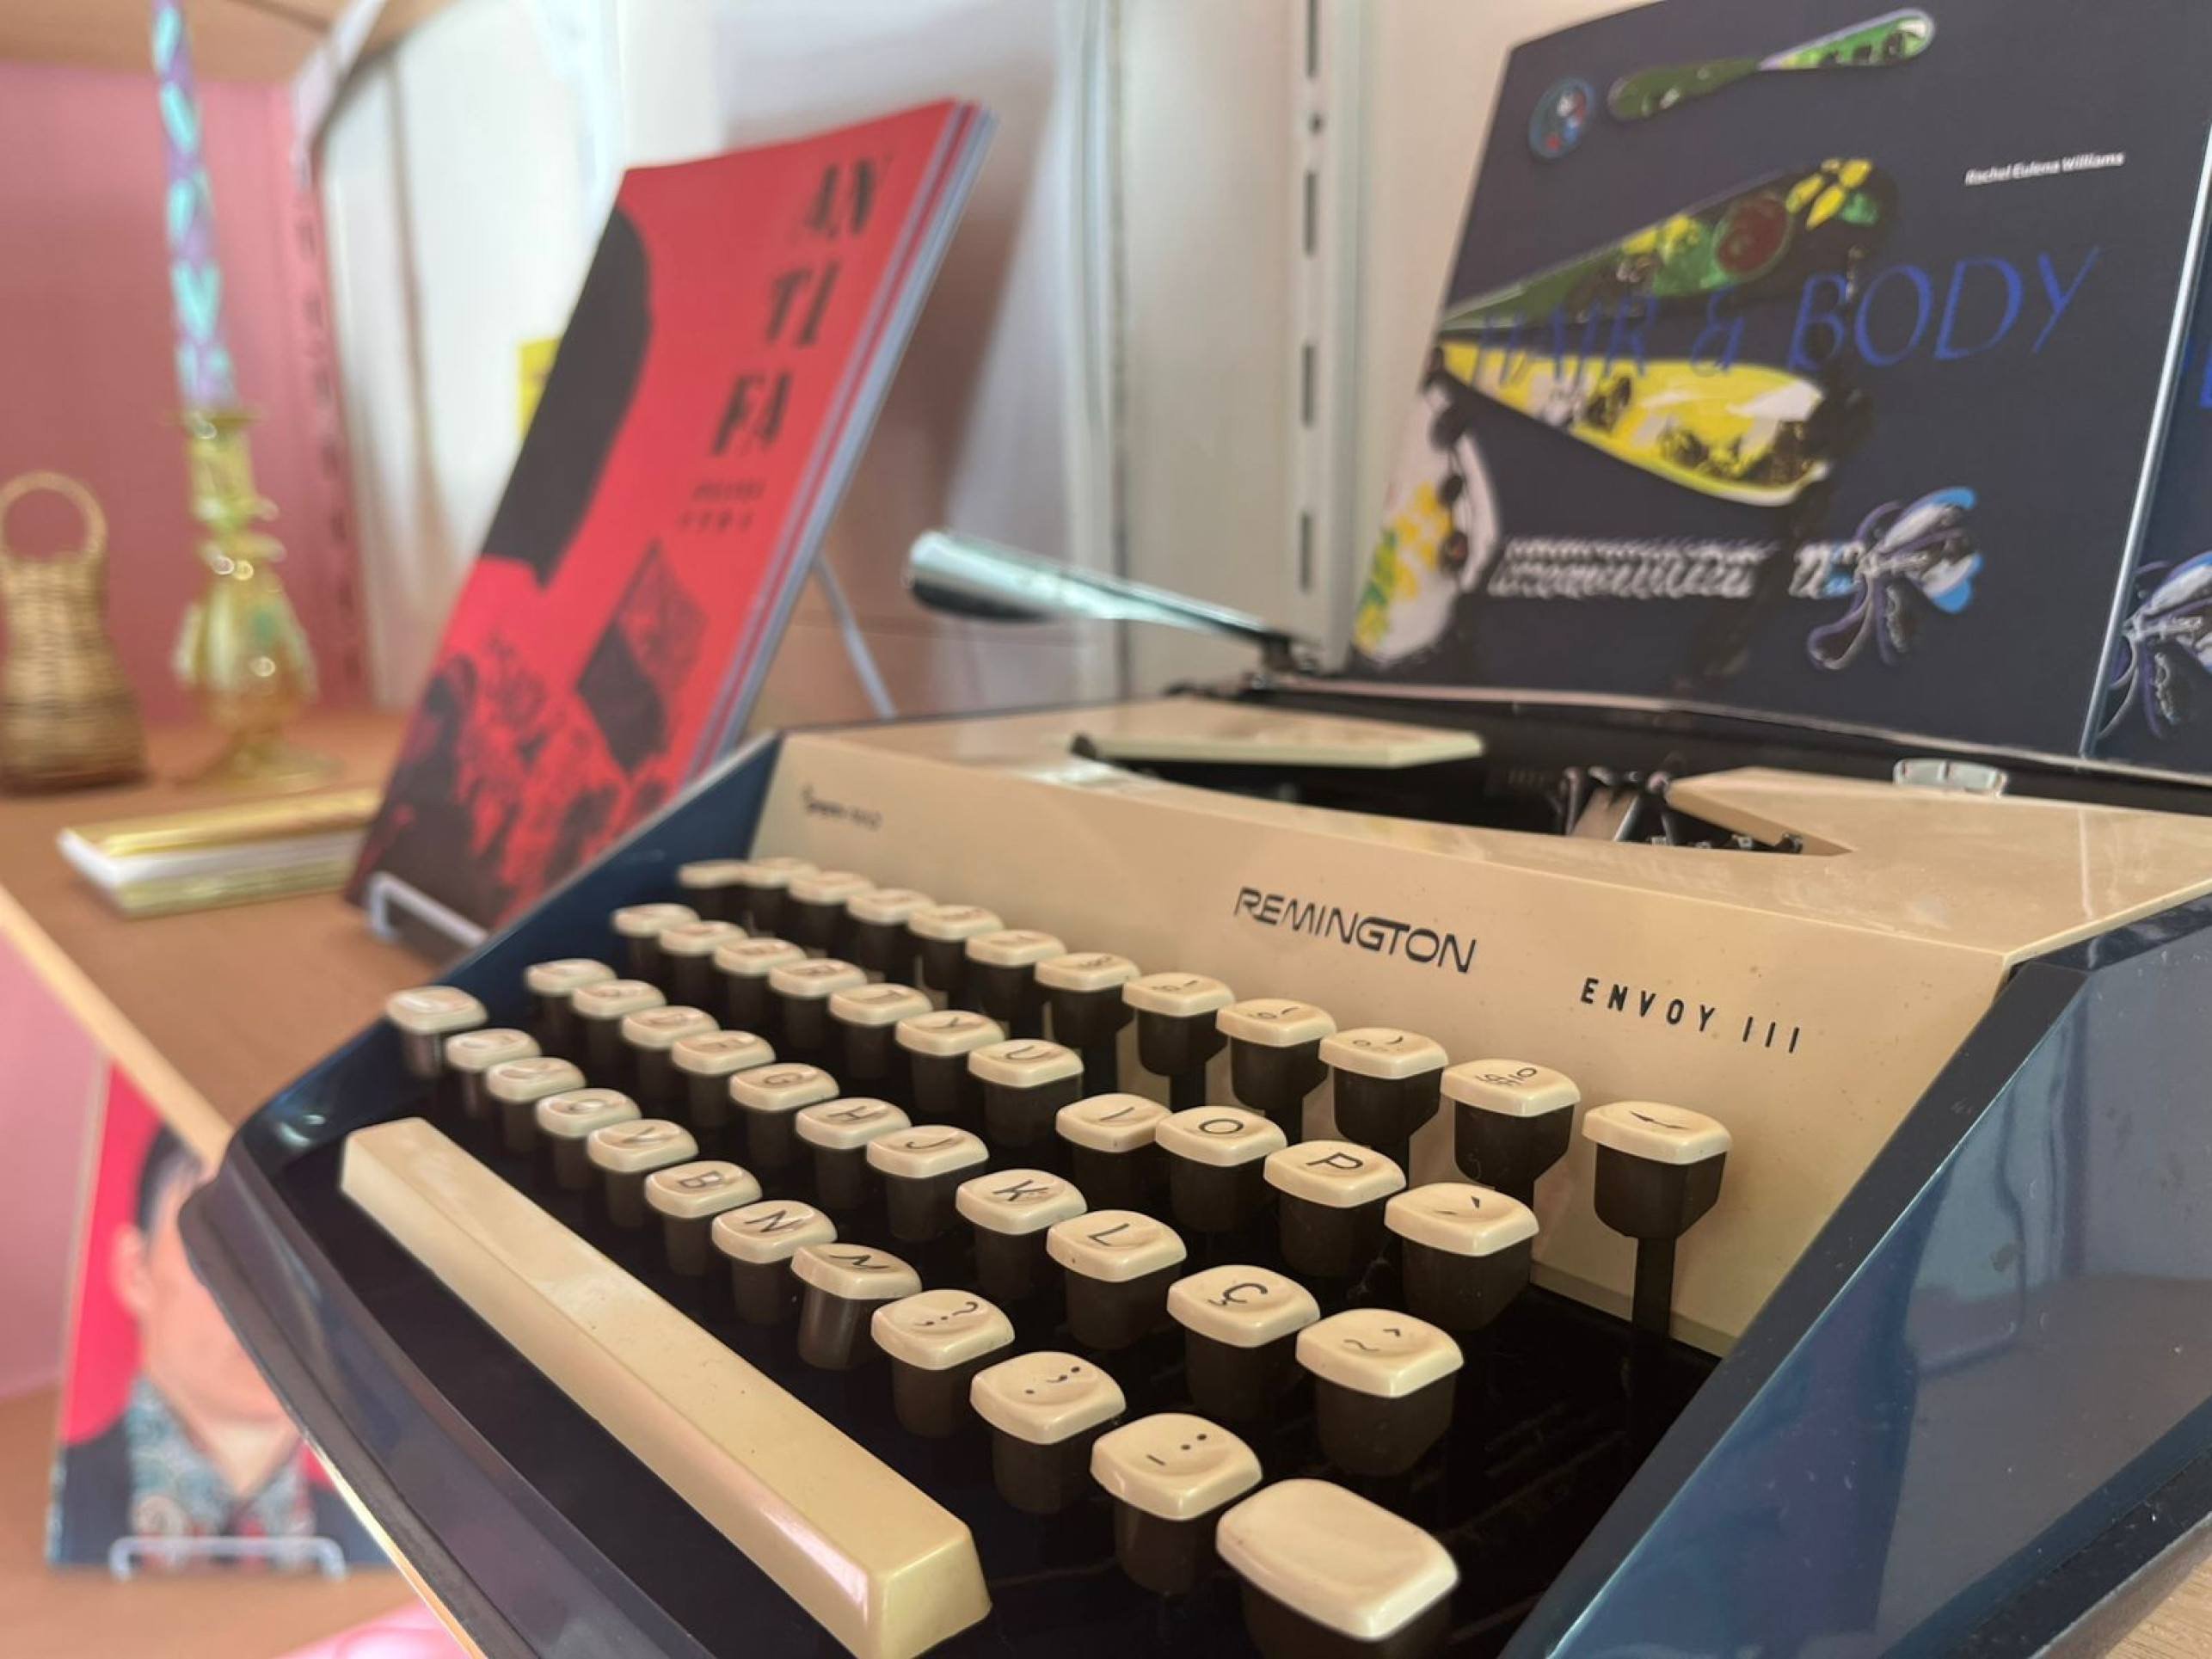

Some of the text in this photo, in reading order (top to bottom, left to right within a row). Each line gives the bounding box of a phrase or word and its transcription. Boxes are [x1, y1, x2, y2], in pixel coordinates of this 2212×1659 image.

[2062, 151, 2125, 171] Williams
[1788, 245, 2099, 372] BODY
[1234, 886, 1477, 974] REMINGTON
[1581, 977, 1801, 1054] ENVOY III
[1305, 1151, 1364, 1171] P
[678, 1170, 724, 1189] B
[992, 1178, 1051, 1202] K
[742, 1208, 804, 1233] N
[1086, 1222, 1131, 1247] L
